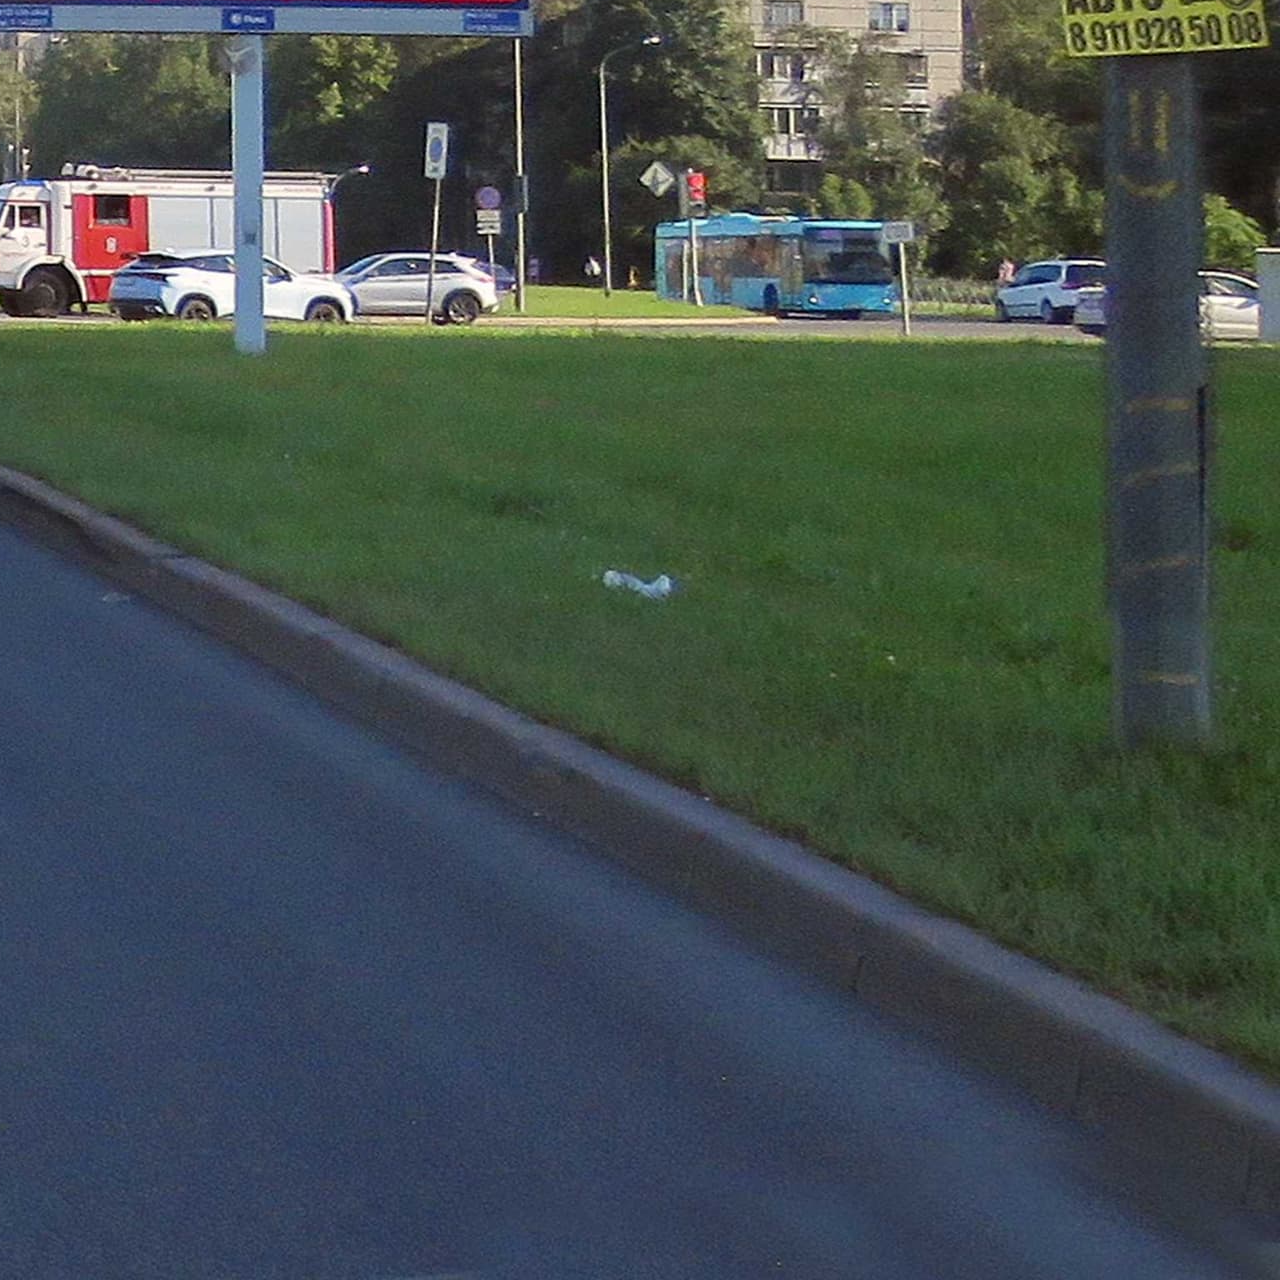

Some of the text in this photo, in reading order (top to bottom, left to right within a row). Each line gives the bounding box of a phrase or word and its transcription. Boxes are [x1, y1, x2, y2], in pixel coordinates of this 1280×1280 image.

[1069, 11, 1262, 52] 8 911 928 50 08
